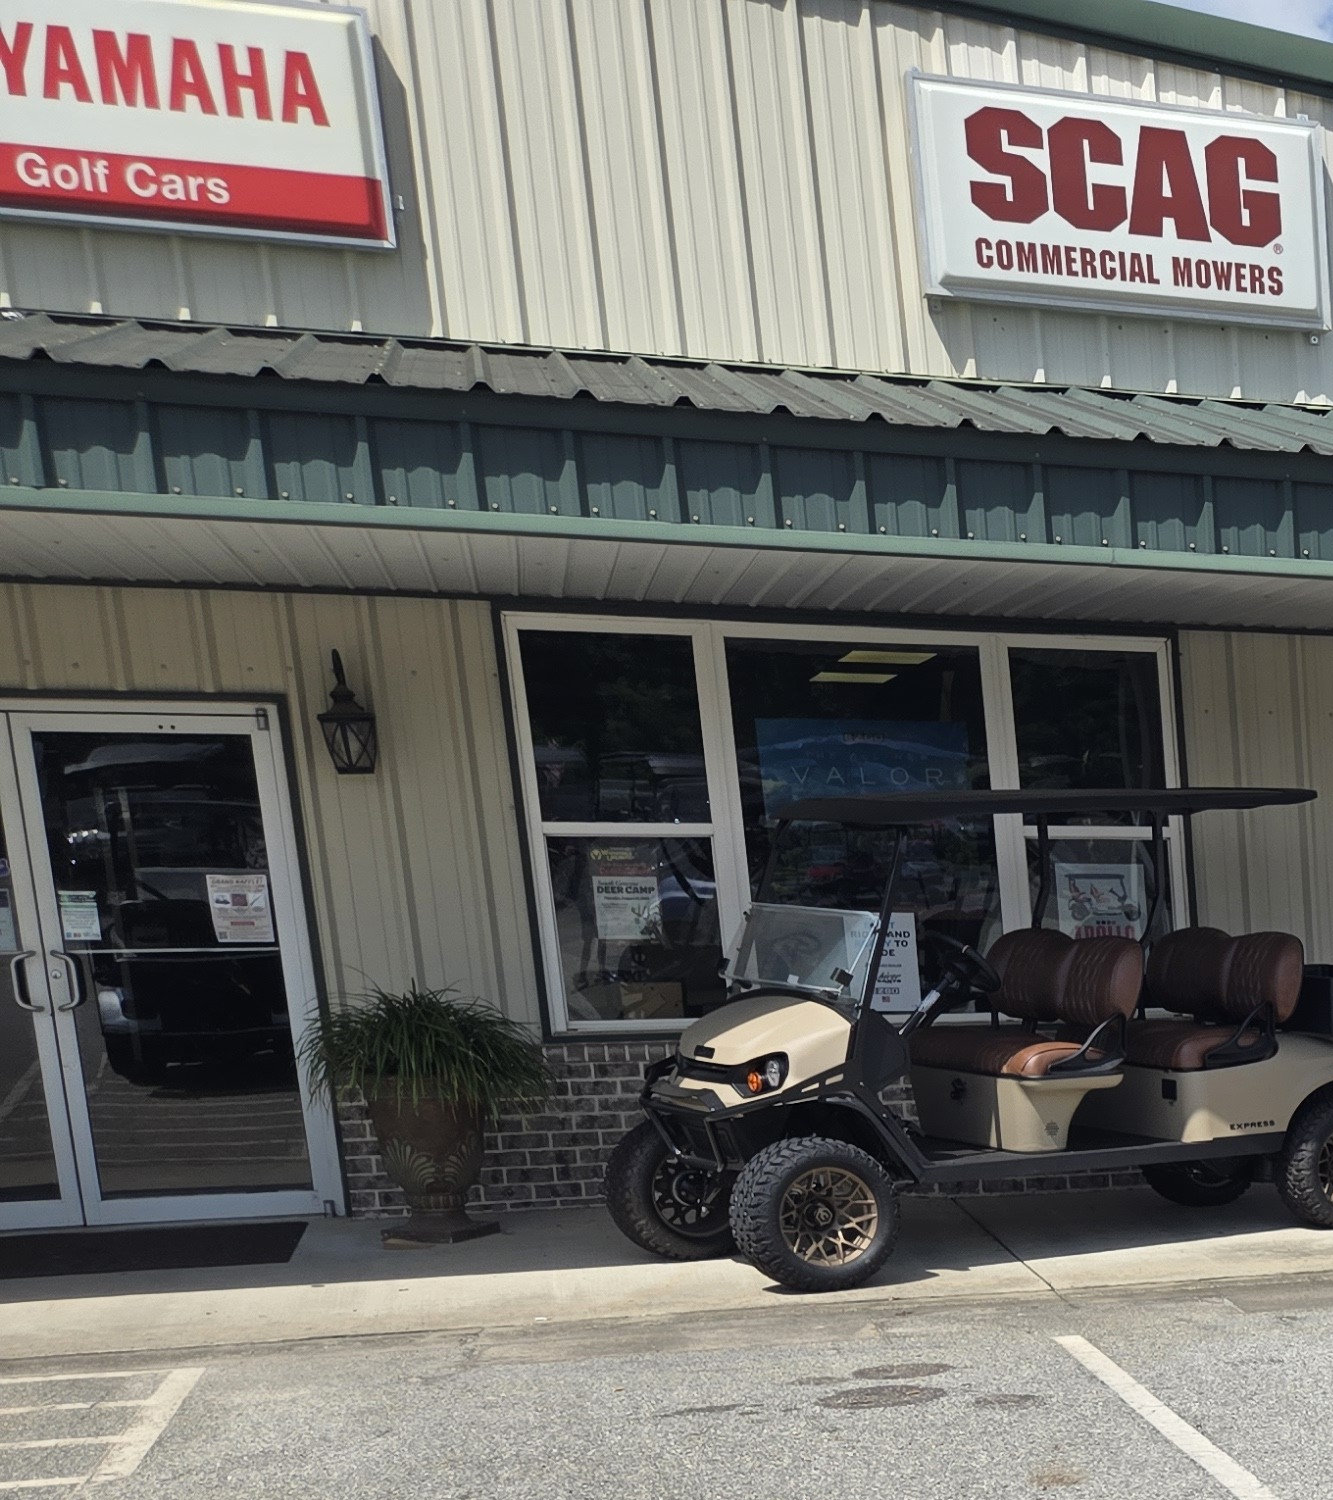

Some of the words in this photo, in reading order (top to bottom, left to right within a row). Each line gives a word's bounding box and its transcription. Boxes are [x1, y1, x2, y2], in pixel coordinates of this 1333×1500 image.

[0, 22, 331, 127] YAMAHA
[15, 152, 109, 193] Golf
[125, 162, 231, 204] Cars
[964, 106, 1283, 248] SCAG
[975, 237, 1161, 285] COMMERCIAL
[1172, 256, 1284, 296] MOWERS
[791, 766, 945, 786] VALOR
[625, 886, 655, 894] CAMP
[1230, 1120, 1276, 1131] EXPRESS
